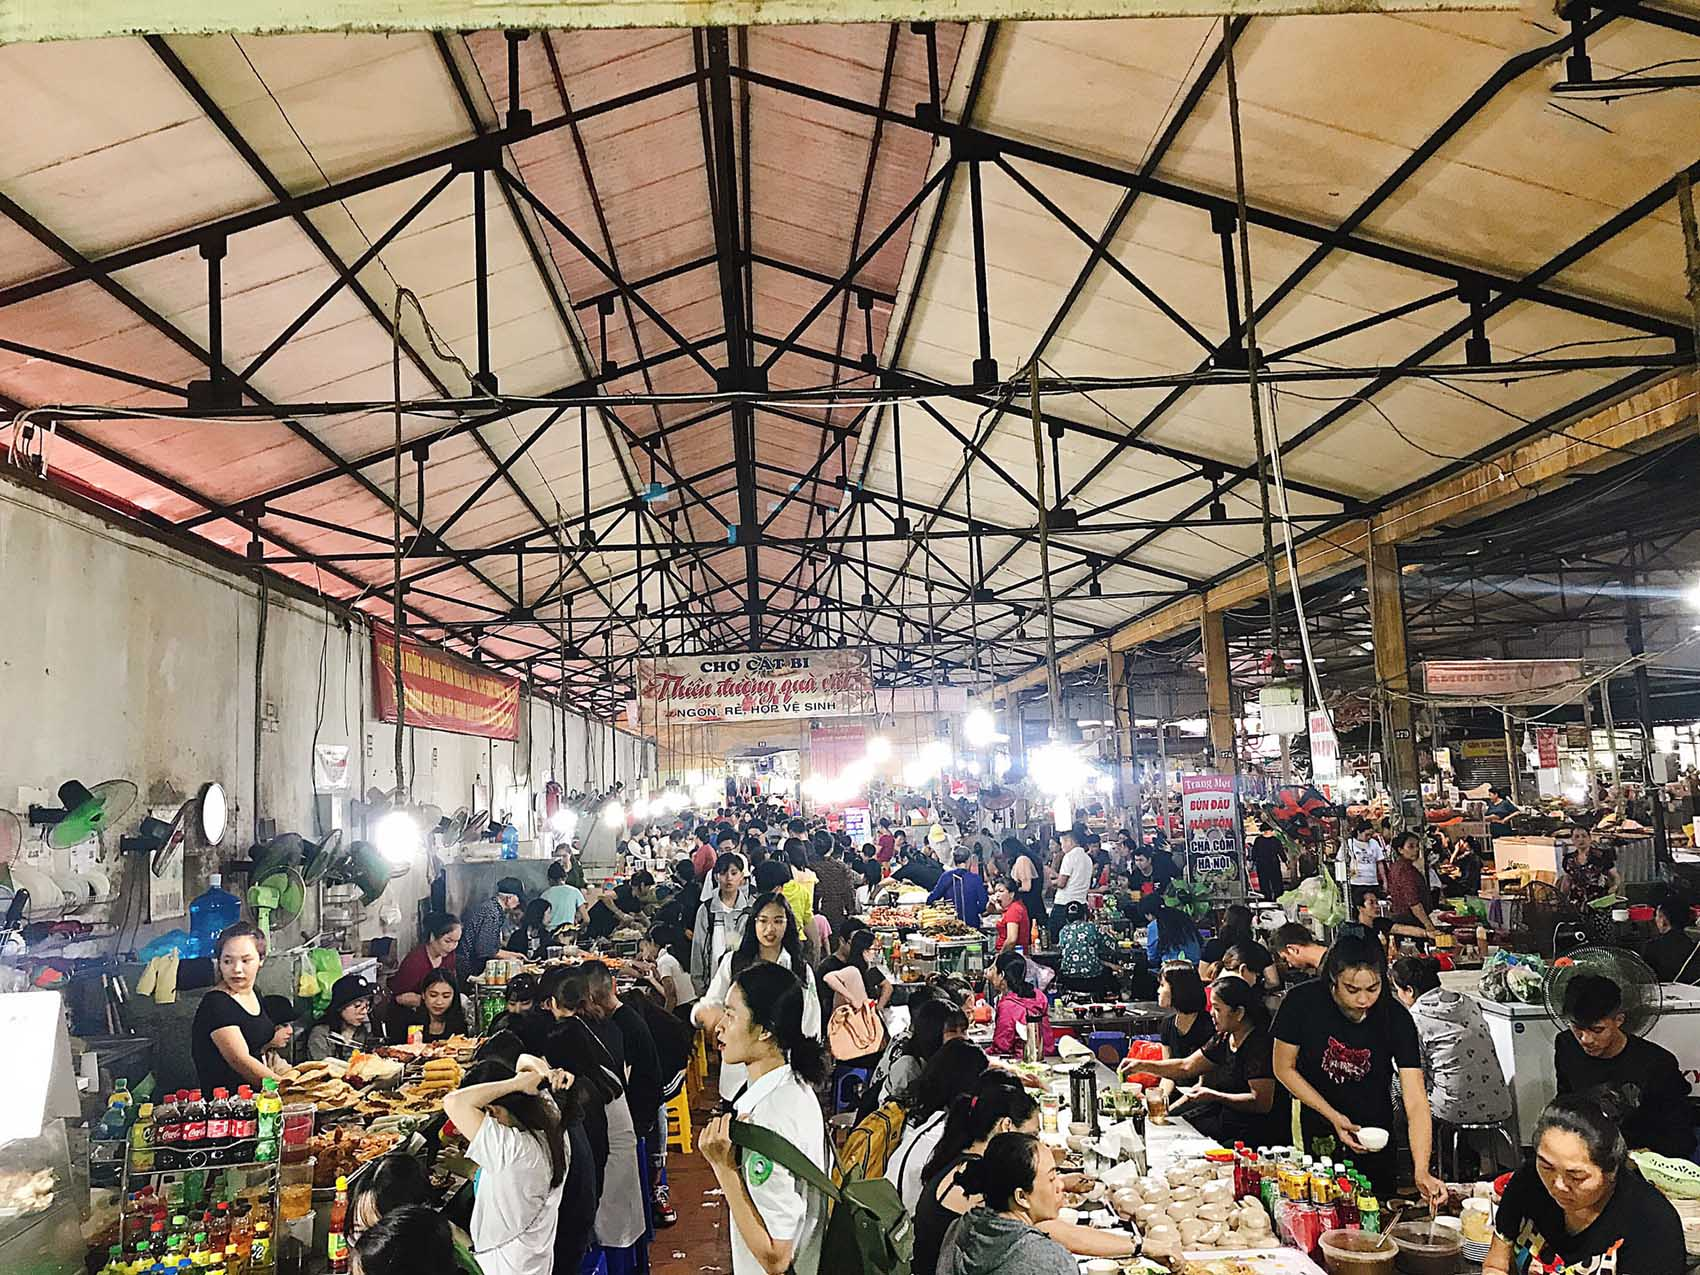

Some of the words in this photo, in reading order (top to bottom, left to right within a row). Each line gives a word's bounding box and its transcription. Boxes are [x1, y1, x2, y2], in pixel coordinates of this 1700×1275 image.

[700, 658, 741, 675] CHỢ
[791, 657, 809, 669] BI
[656, 672, 713, 702] Thiên
[780, 671, 817, 704] quà
[804, 701, 836, 711] SINH
[1213, 855, 1230, 871] NỘI
